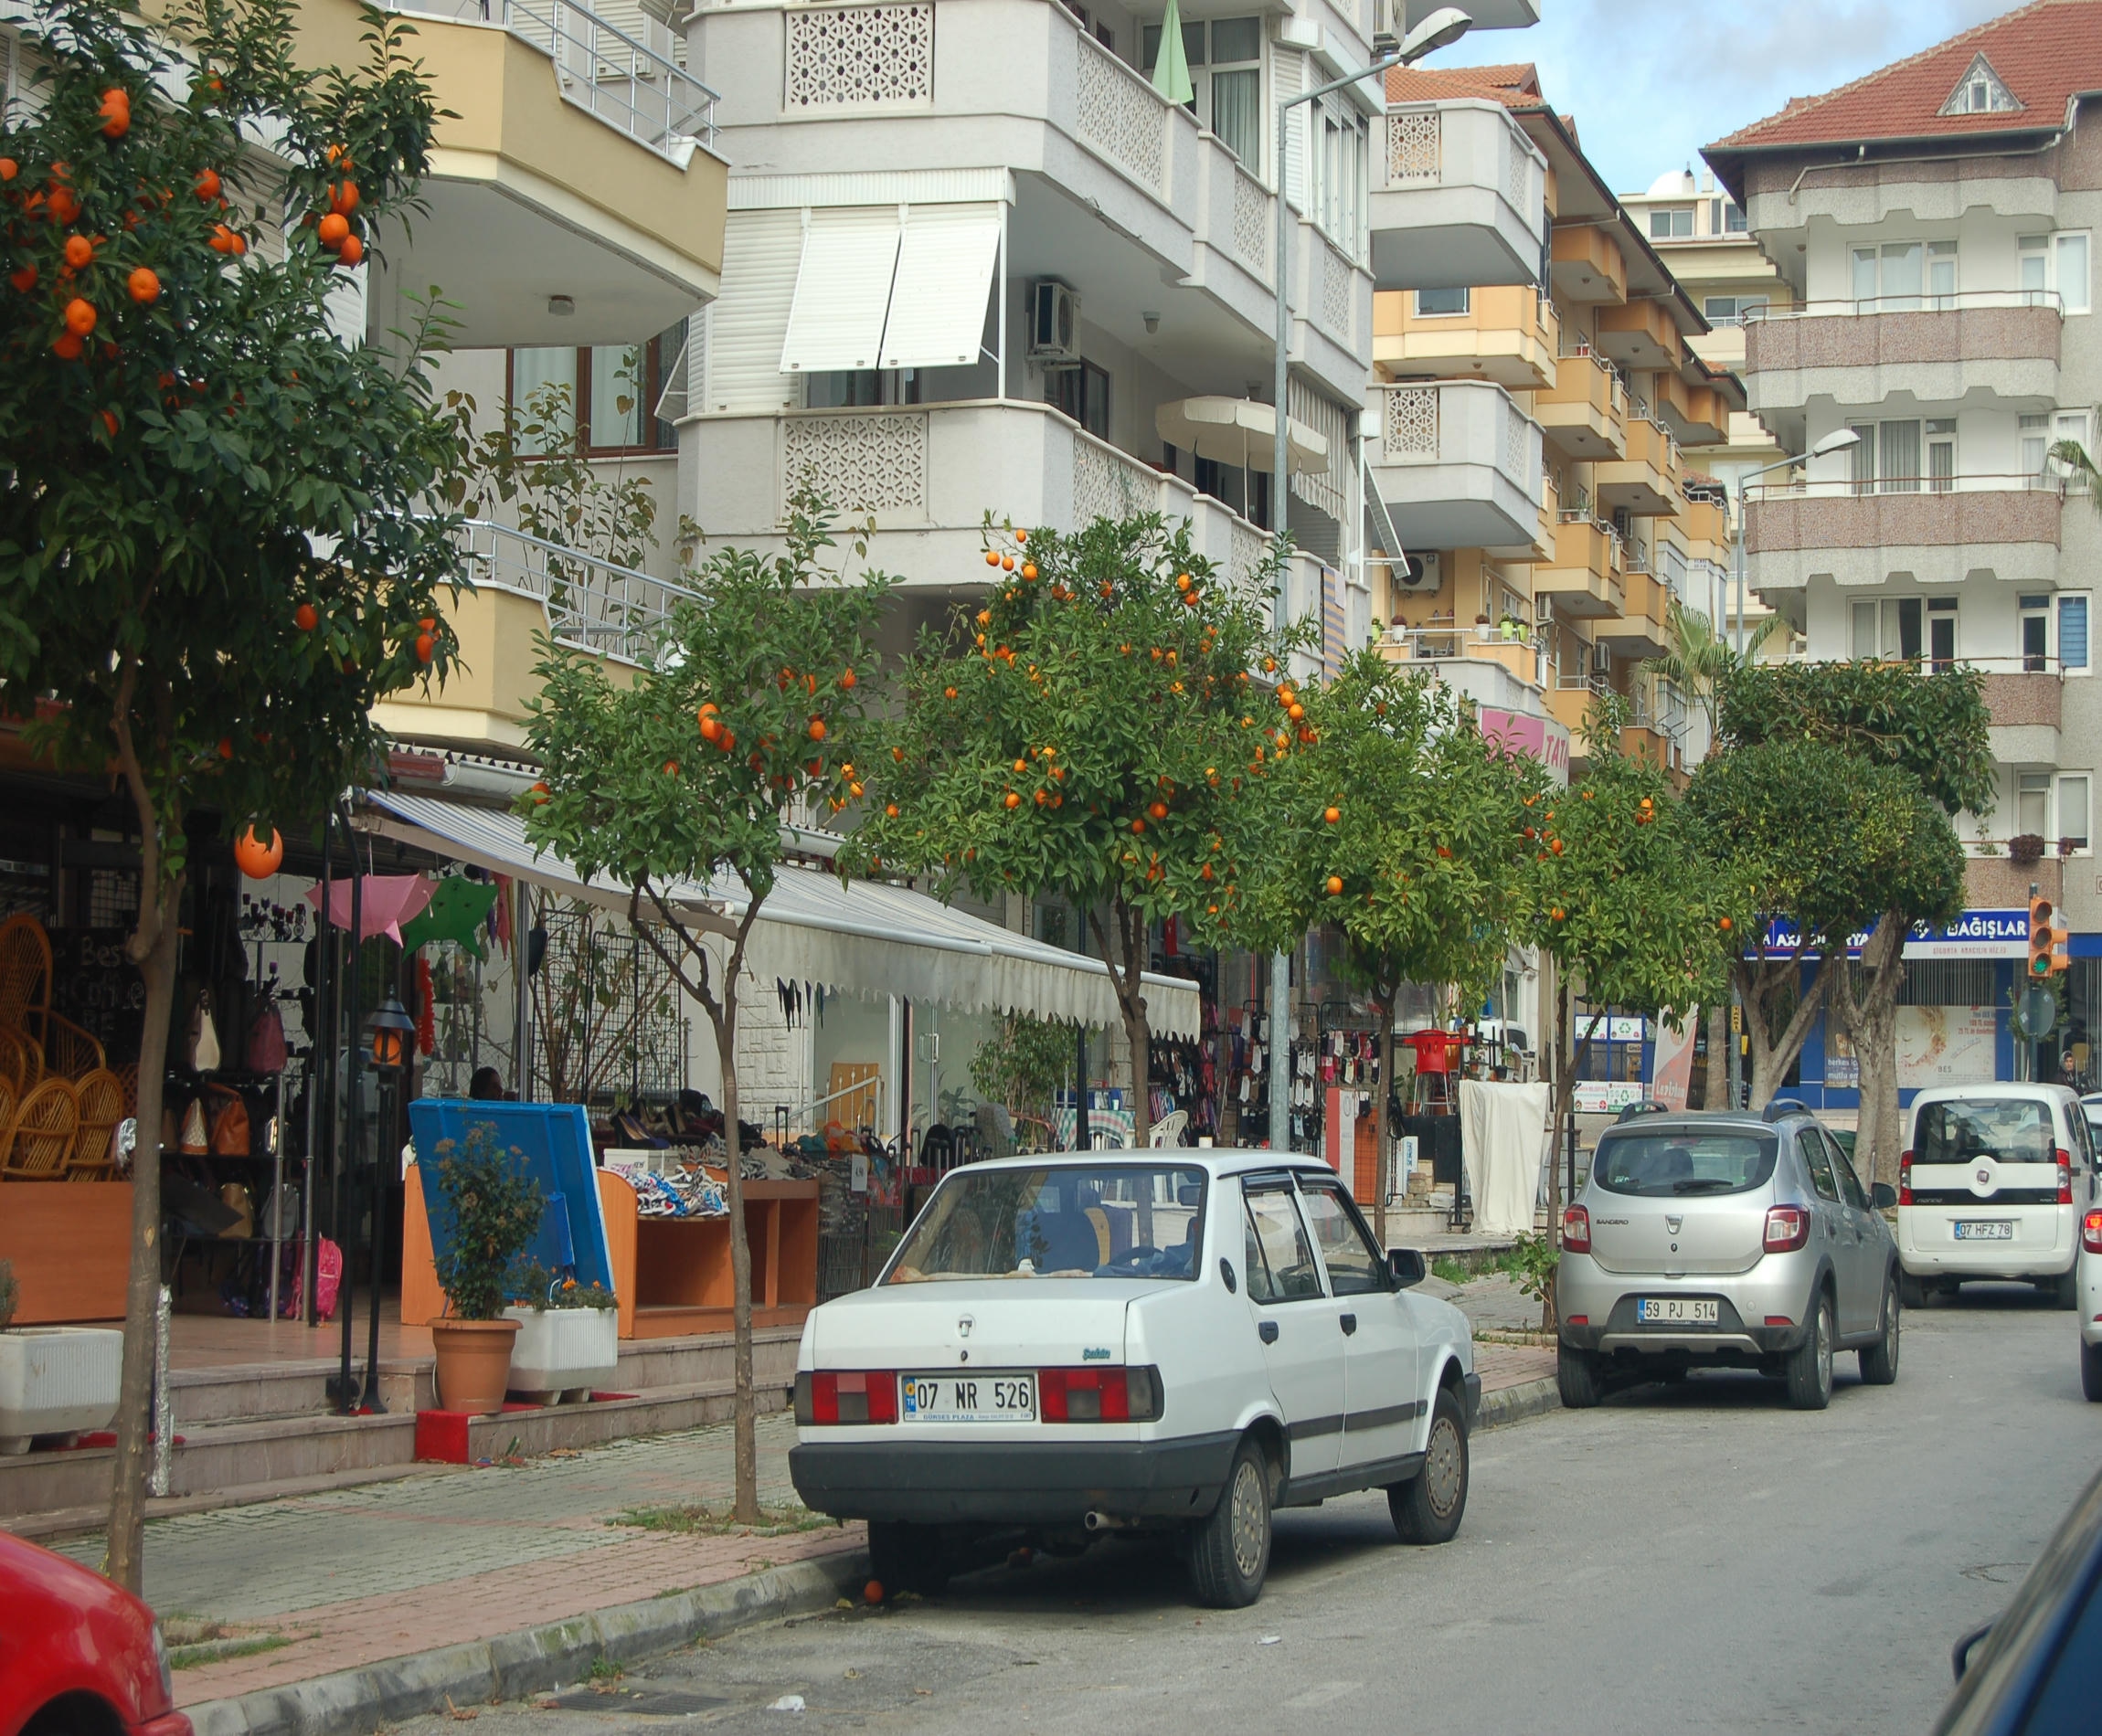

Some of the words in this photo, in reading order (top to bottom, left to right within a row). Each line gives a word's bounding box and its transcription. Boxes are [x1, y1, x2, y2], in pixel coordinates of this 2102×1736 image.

[1959, 1224, 1972, 1235] 07
[1976, 1224, 1995, 1235] HFZ
[1998, 1224, 2010, 1235] 78
[1646, 1301, 1660, 1318] 59
[1669, 1302, 1683, 1318] PJ
[1694, 1302, 1716, 1319] 514
[918, 1382, 939, 1409] 07
[955, 1381, 978, 1409] NR
[994, 1381, 1029, 1409] 526
[906, 1398, 915, 1407] TR
